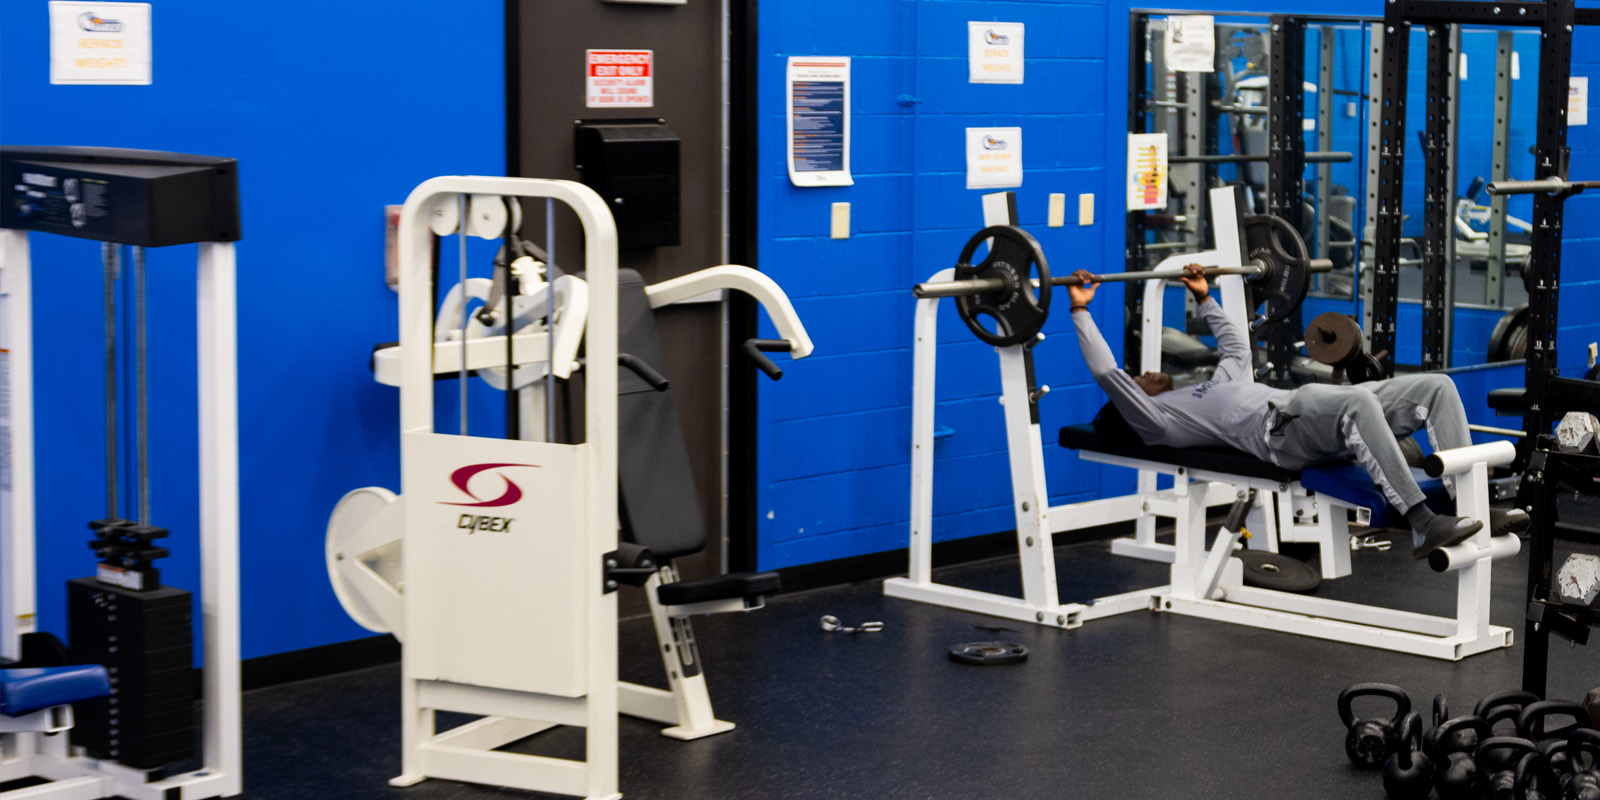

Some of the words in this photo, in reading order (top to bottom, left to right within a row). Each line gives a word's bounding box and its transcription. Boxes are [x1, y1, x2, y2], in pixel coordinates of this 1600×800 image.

[589, 54, 649, 64] EMERGENCY
[596, 66, 617, 76] EXIT
[618, 66, 643, 76] ONLY
[457, 513, 514, 534] CYBEX
